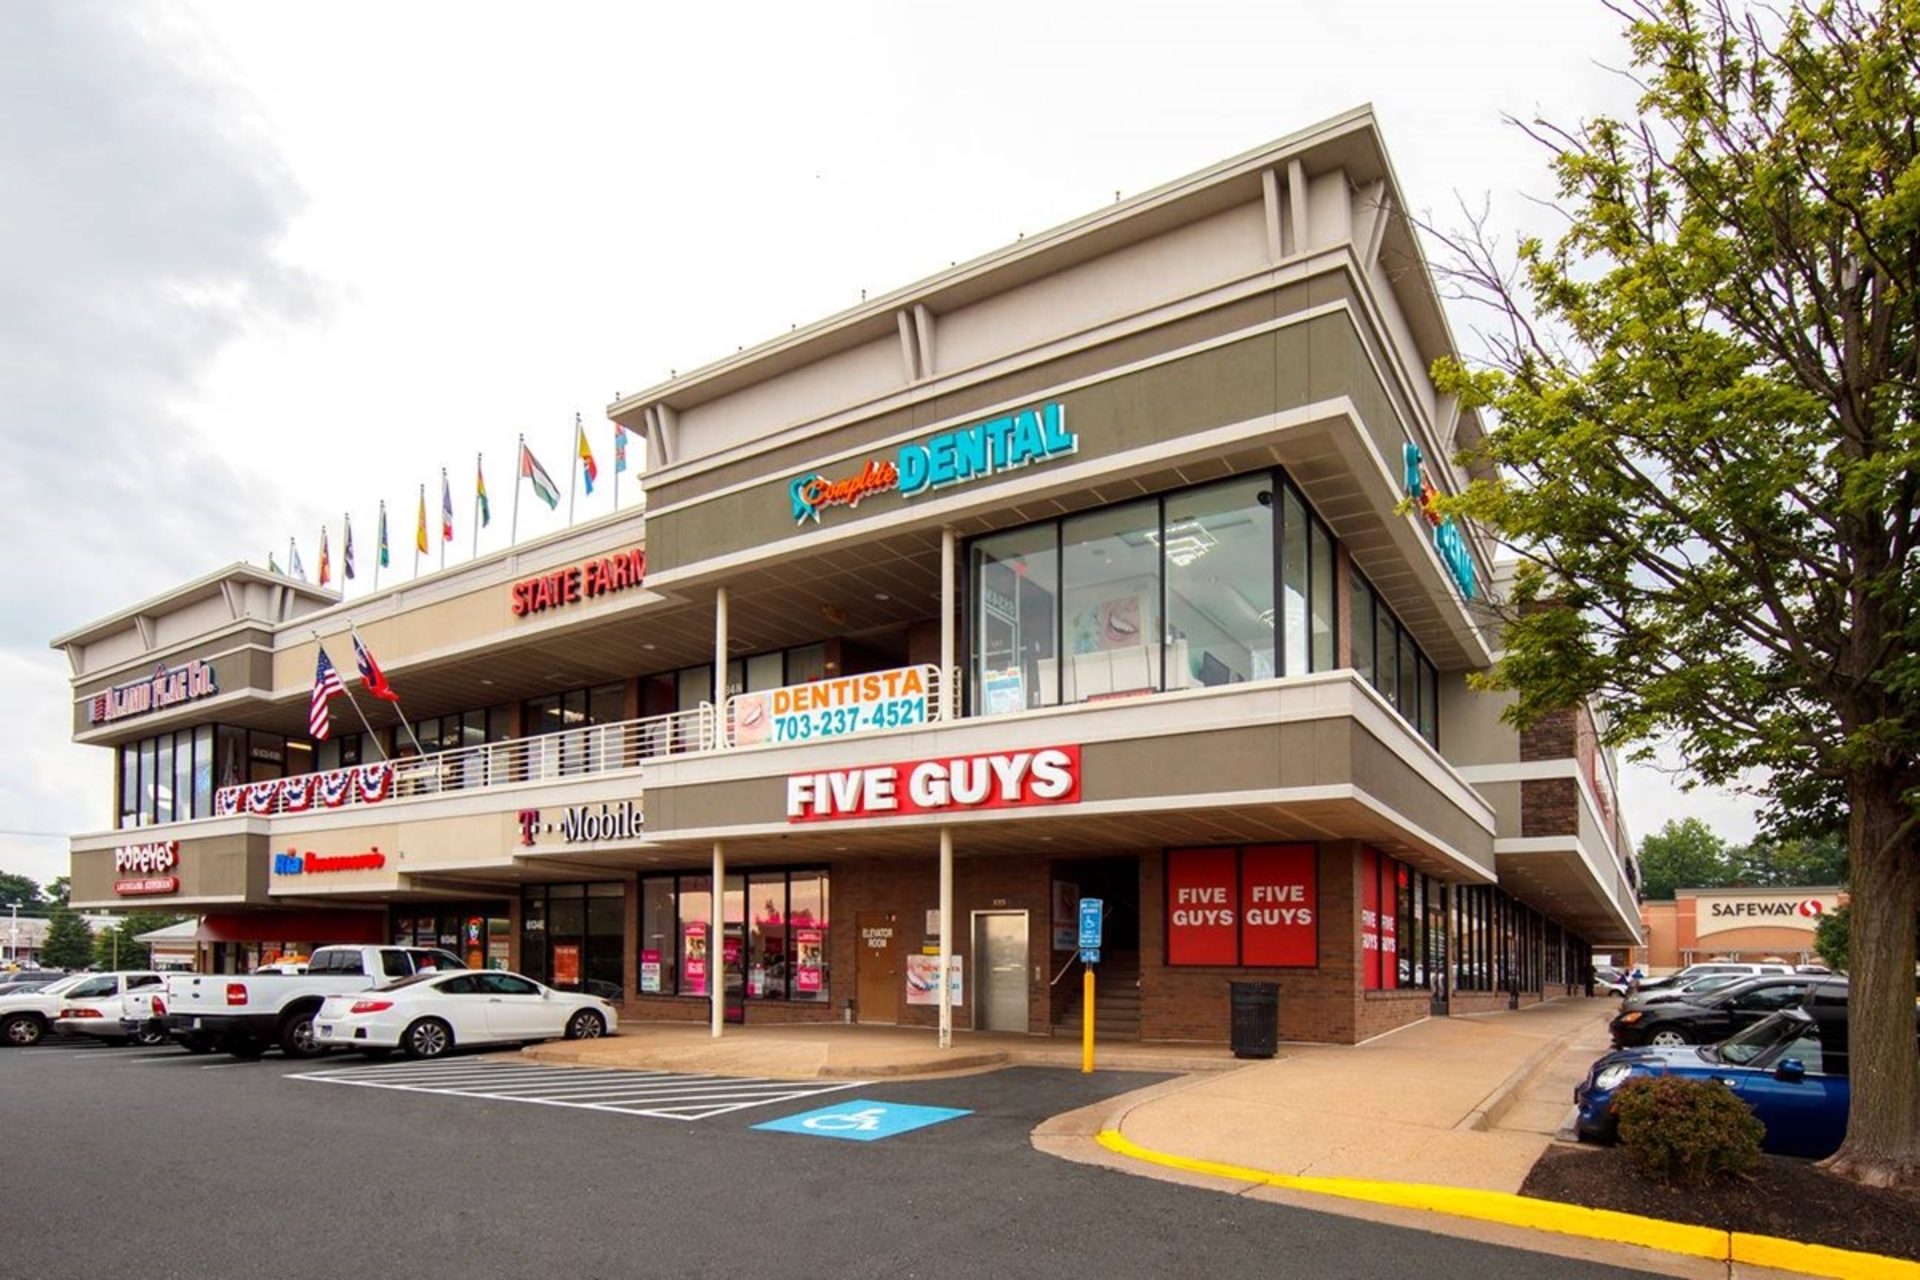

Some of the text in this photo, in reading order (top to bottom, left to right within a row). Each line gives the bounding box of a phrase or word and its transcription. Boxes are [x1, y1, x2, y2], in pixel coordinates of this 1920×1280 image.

[801, 401, 1078, 508] Complete DENTAL
[511, 566, 581, 617] STATE
[773, 668, 923, 715] DENTISTA
[775, 696, 925, 742] 703-237-4521
[787, 749, 1074, 818] FIVE GUYS
[1178, 887, 1228, 904] FIVE
[1252, 885, 1305, 903] FIVE
[1172, 909, 1235, 926] GUYS
[1246, 908, 1312, 926] GUYS
[1711, 902, 1798, 917] SAFEWAY
[862, 927, 894, 939] ELEVATOR
[867, 938, 888, 949] ROOM
